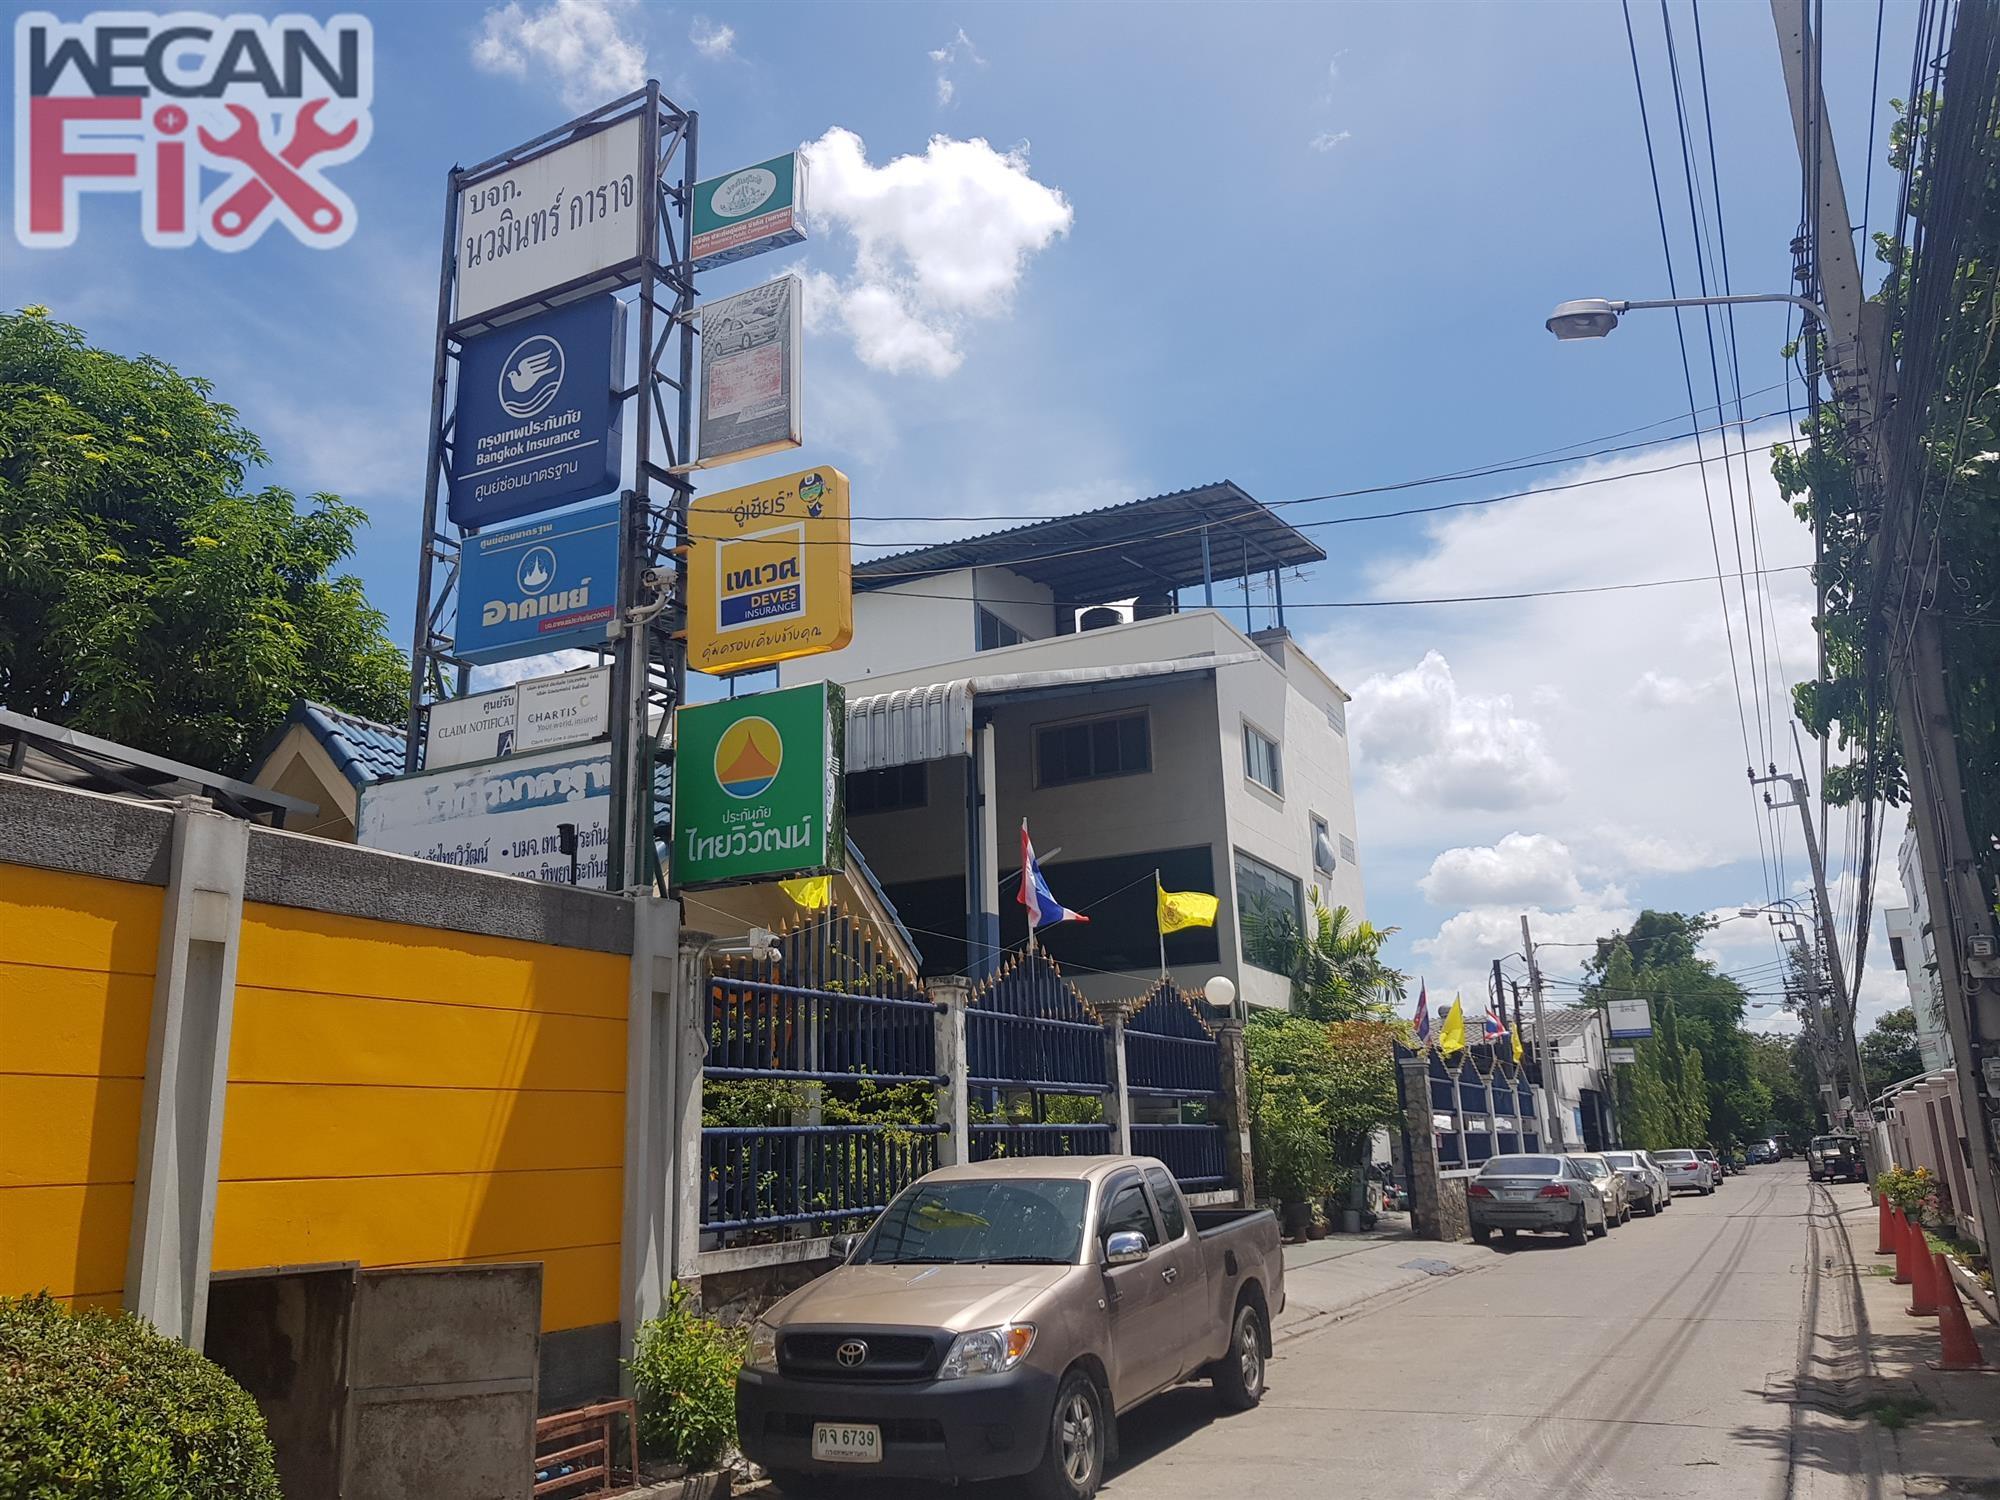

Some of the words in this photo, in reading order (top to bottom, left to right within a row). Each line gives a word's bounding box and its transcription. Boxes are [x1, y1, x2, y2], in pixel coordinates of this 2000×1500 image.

[470, 180, 522, 215] บจก.
[466, 187, 565, 268] นวมินทร์
[570, 174, 634, 231] การาจ
[478, 409, 581, 450] กรุงเทพประกันภัย
[476, 444, 524, 466] Bangkok
[526, 429, 581, 452] Insurance
[475, 461, 578, 502] ศูนย์ซ่อมมาตรฐาน
[726, 557, 800, 591] เทเวศ
[482, 577, 592, 627] อาคเนย์
[744, 602, 797, 619] INSURANCE
[751, 589, 797, 608] DEVES
[527, 706, 577, 723] CHARTIS
[438, 726, 467, 739] CLAIM
[722, 806, 772, 824] ประกันภัย
[512, 839, 539, 858] บมจ.
[685, 815, 812, 862] ไทยวิวัฒน์
[843, 1430, 874, 1446] 6739
